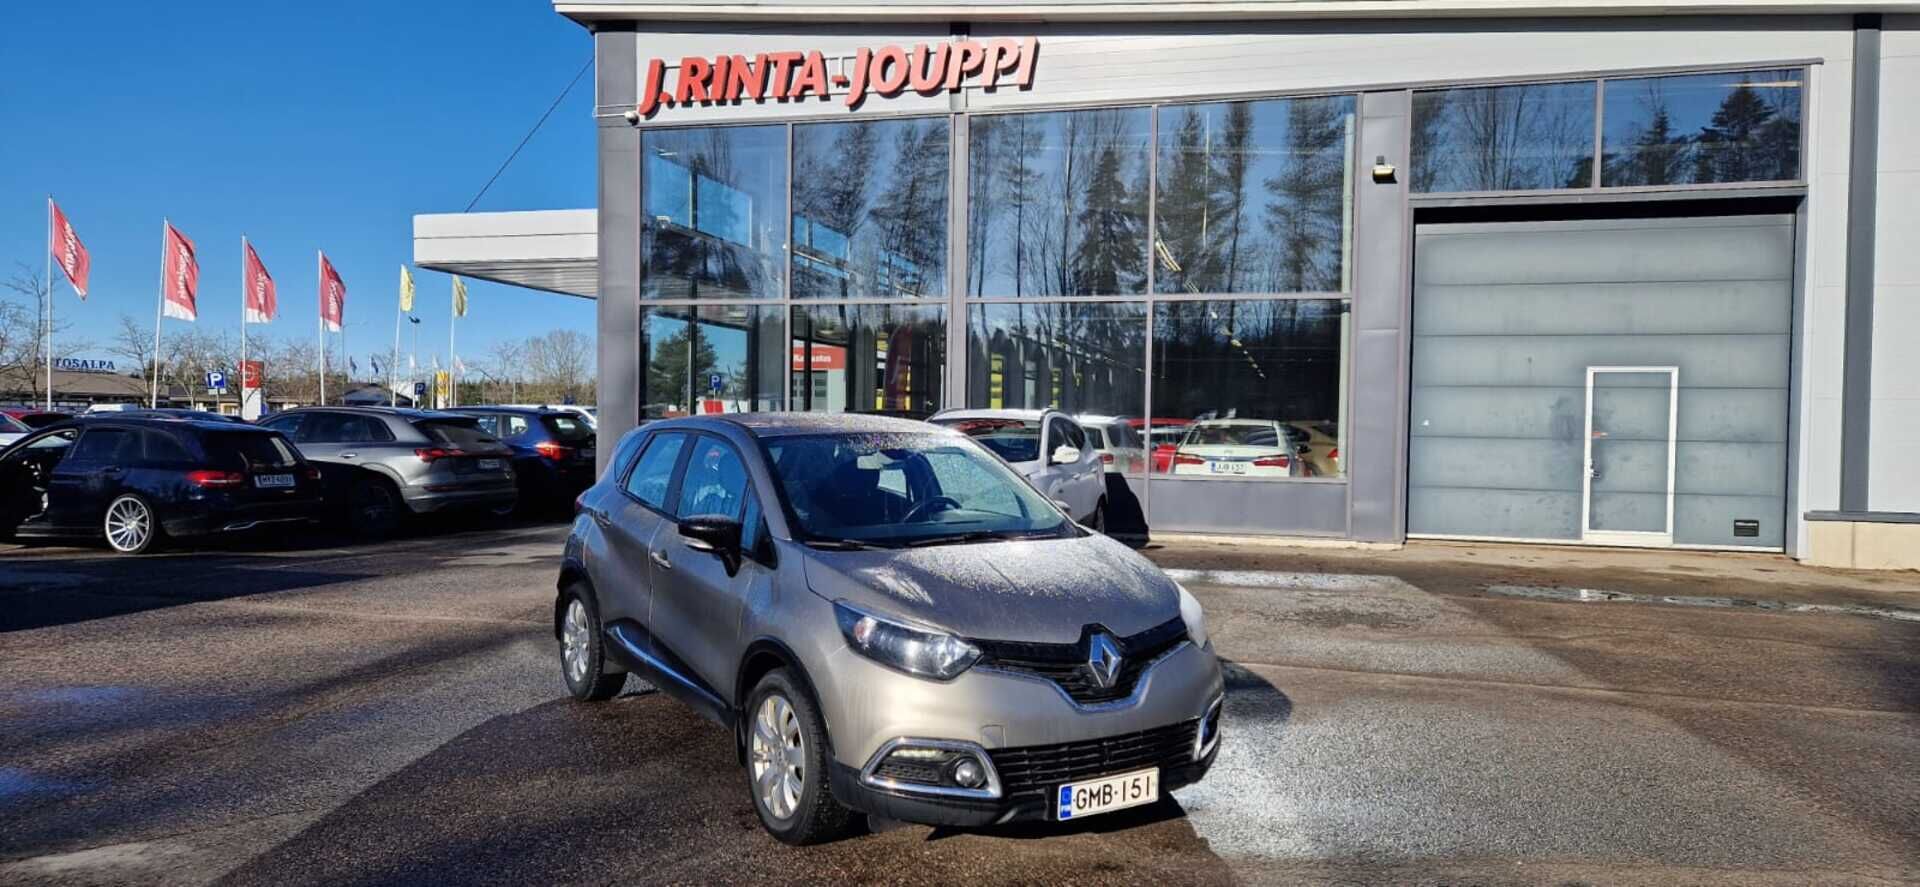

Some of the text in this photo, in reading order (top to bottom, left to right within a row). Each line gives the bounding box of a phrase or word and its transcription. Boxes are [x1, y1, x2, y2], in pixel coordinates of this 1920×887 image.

[639, 36, 1039, 117] J.RINTA-JOUPPI
[210, 373, 222, 387] P
[711, 375, 720, 387] P
